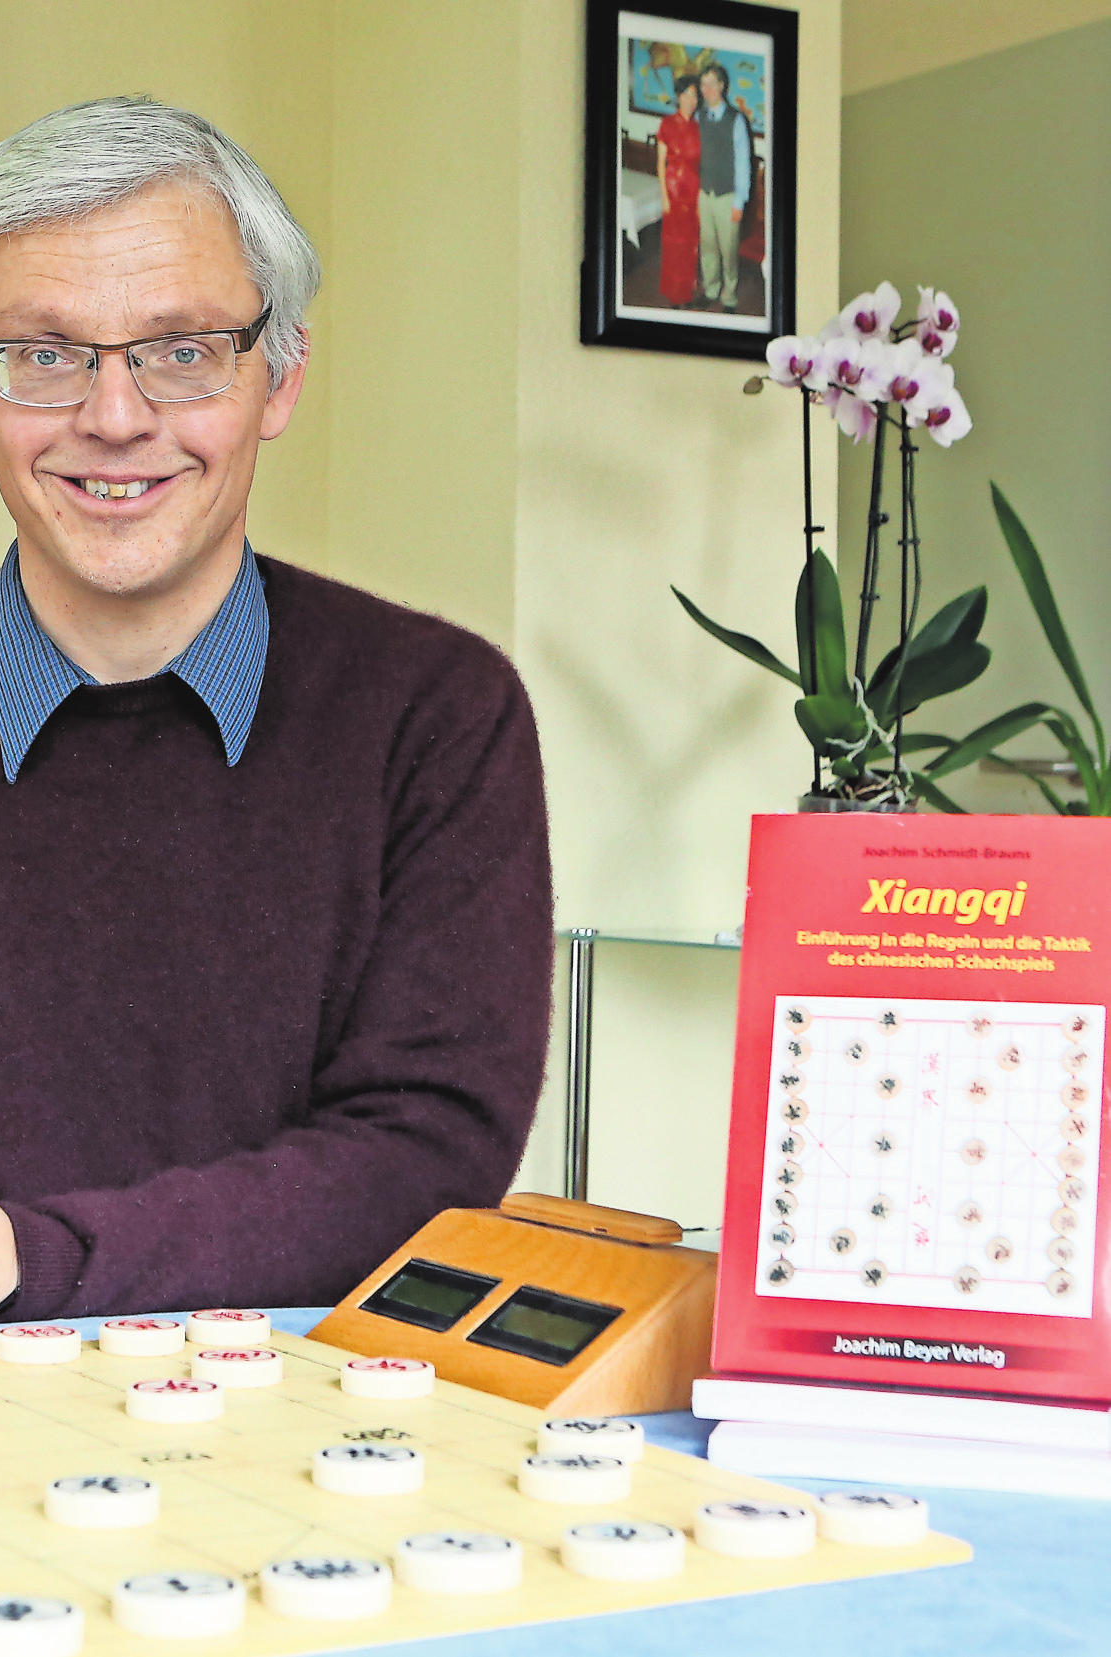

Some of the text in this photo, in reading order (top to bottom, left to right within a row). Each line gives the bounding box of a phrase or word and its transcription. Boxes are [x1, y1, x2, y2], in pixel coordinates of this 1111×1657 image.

[860, 878, 1028, 925] Xiangqi
[796, 930, 1092, 952] Einführung in die Regeln und die Taktik
[827, 951, 1056, 973] des chinesischen Schachspiels
[833, 1335, 1006, 1369] Joachim Beyer Verlag
